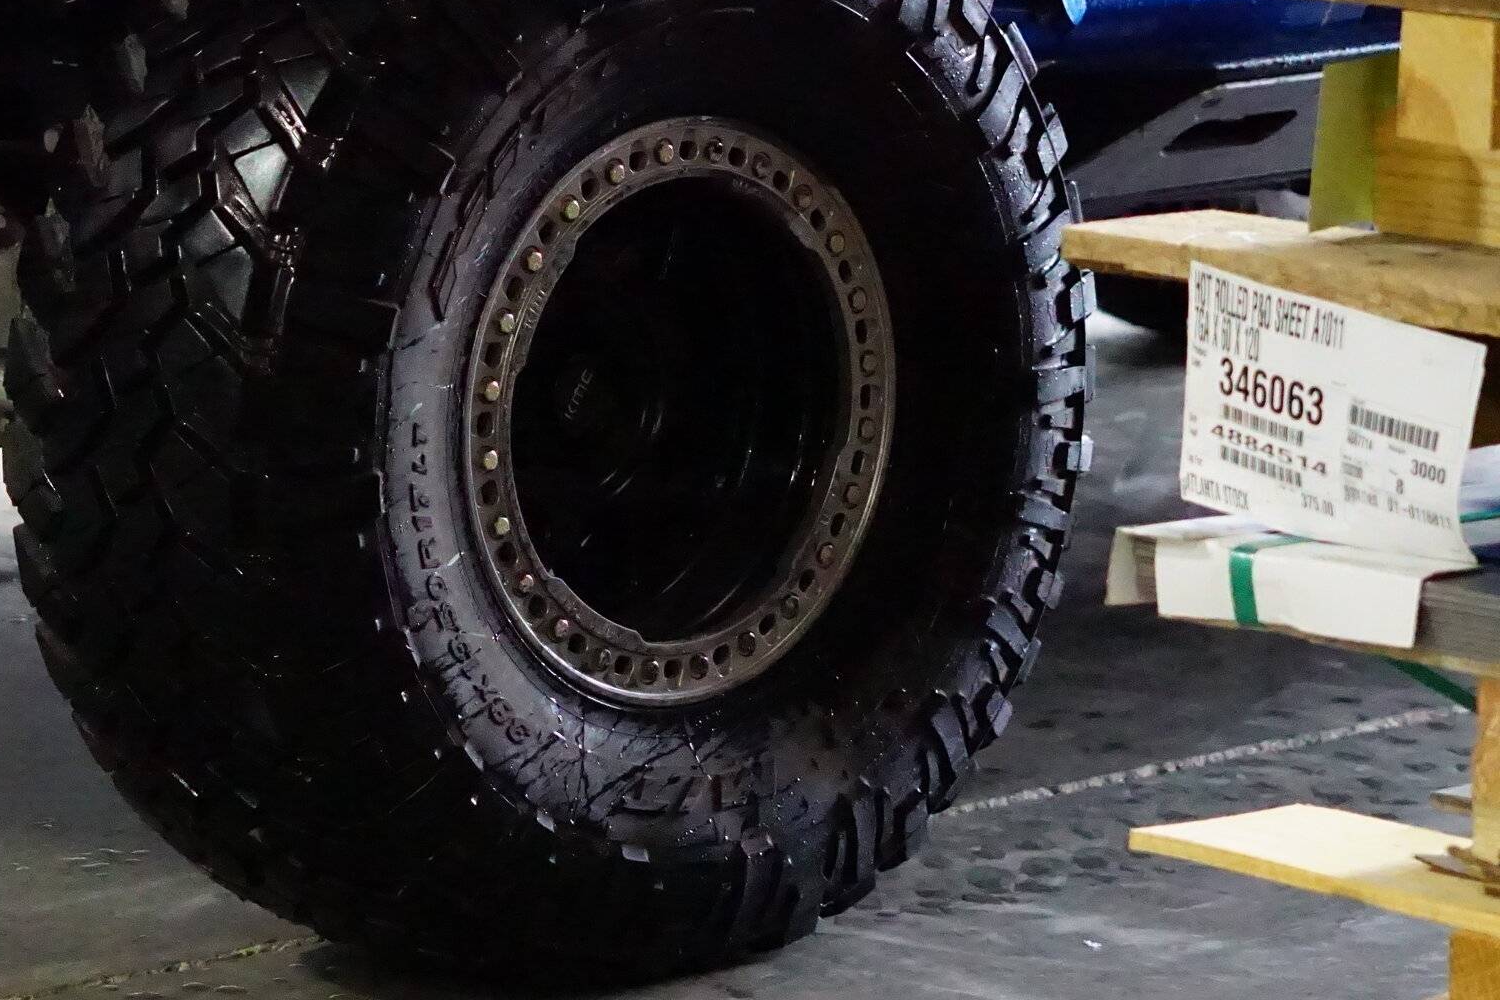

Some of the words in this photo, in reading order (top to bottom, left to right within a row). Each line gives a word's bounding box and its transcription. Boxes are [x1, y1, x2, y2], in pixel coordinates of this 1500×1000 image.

[1194, 270, 1212, 307] HOT
[1214, 278, 1249, 321] ROLLED
[1274, 297, 1310, 340] SHEET
[1219, 357, 1325, 426] 346063
[1210, 424, 1327, 476] 4884514
[1410, 458, 1447, 485] 3000
